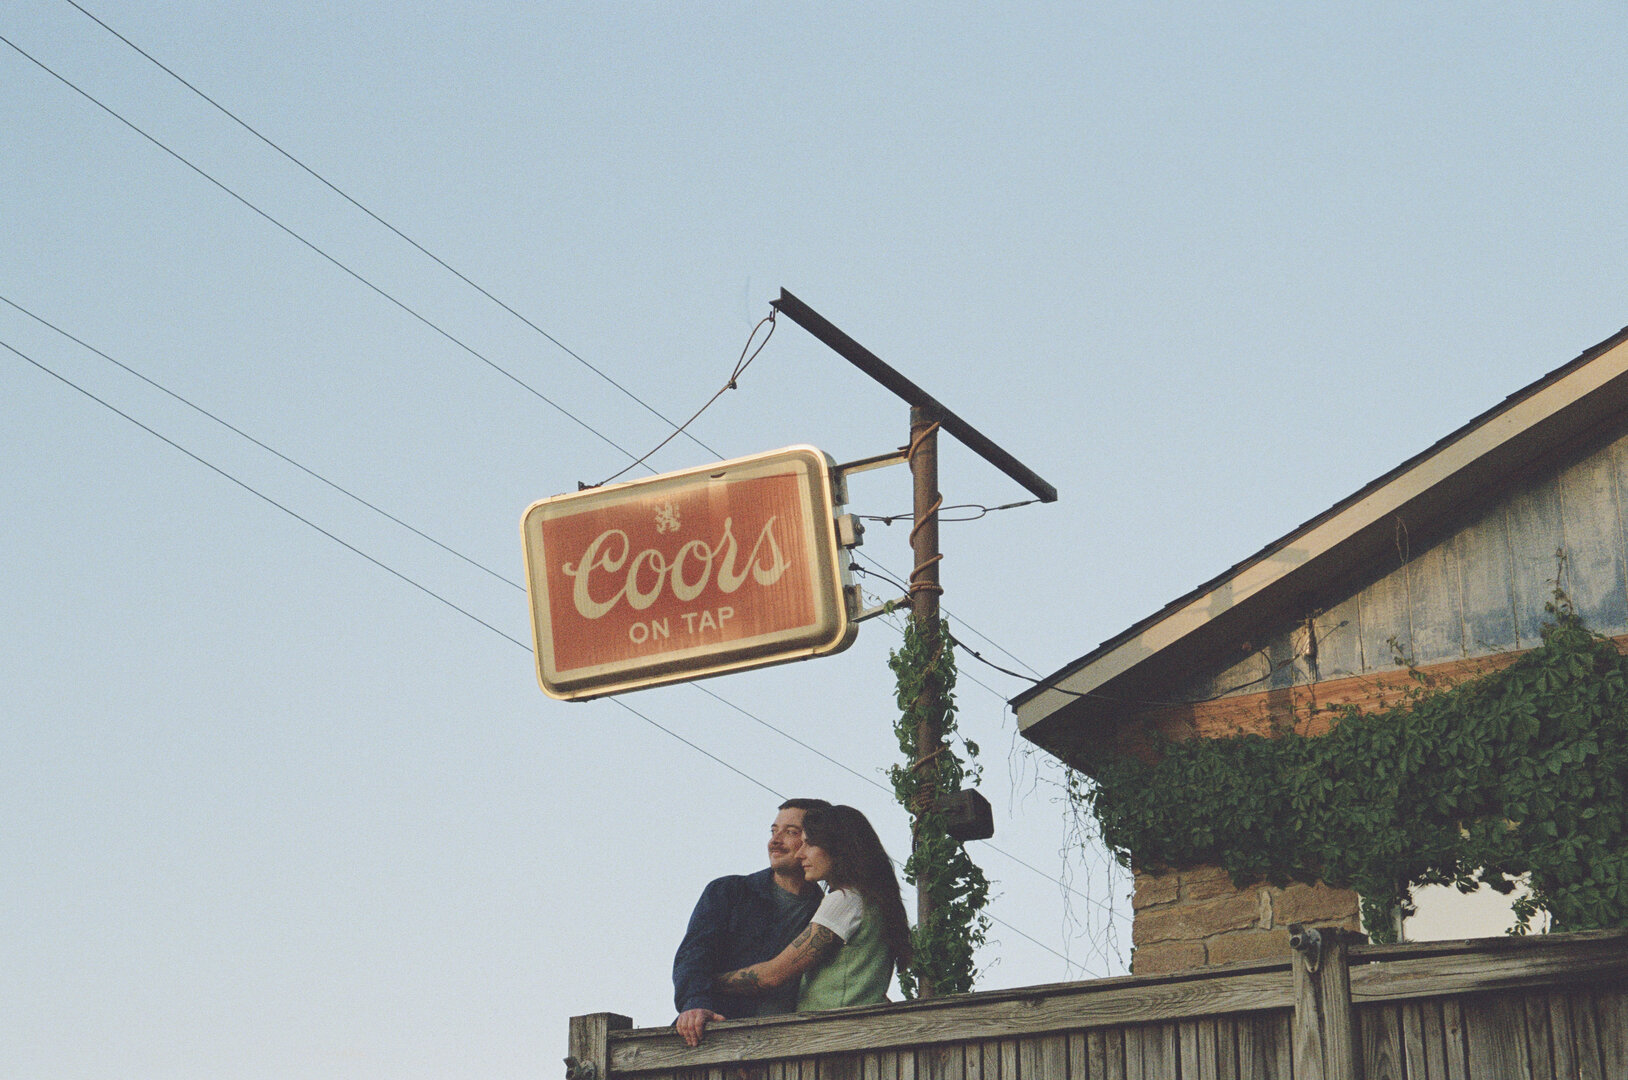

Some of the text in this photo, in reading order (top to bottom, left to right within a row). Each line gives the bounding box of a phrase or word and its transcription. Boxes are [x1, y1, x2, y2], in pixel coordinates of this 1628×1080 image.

[562, 515, 791, 619] Coors
[629, 606, 735, 644] ON TAP
